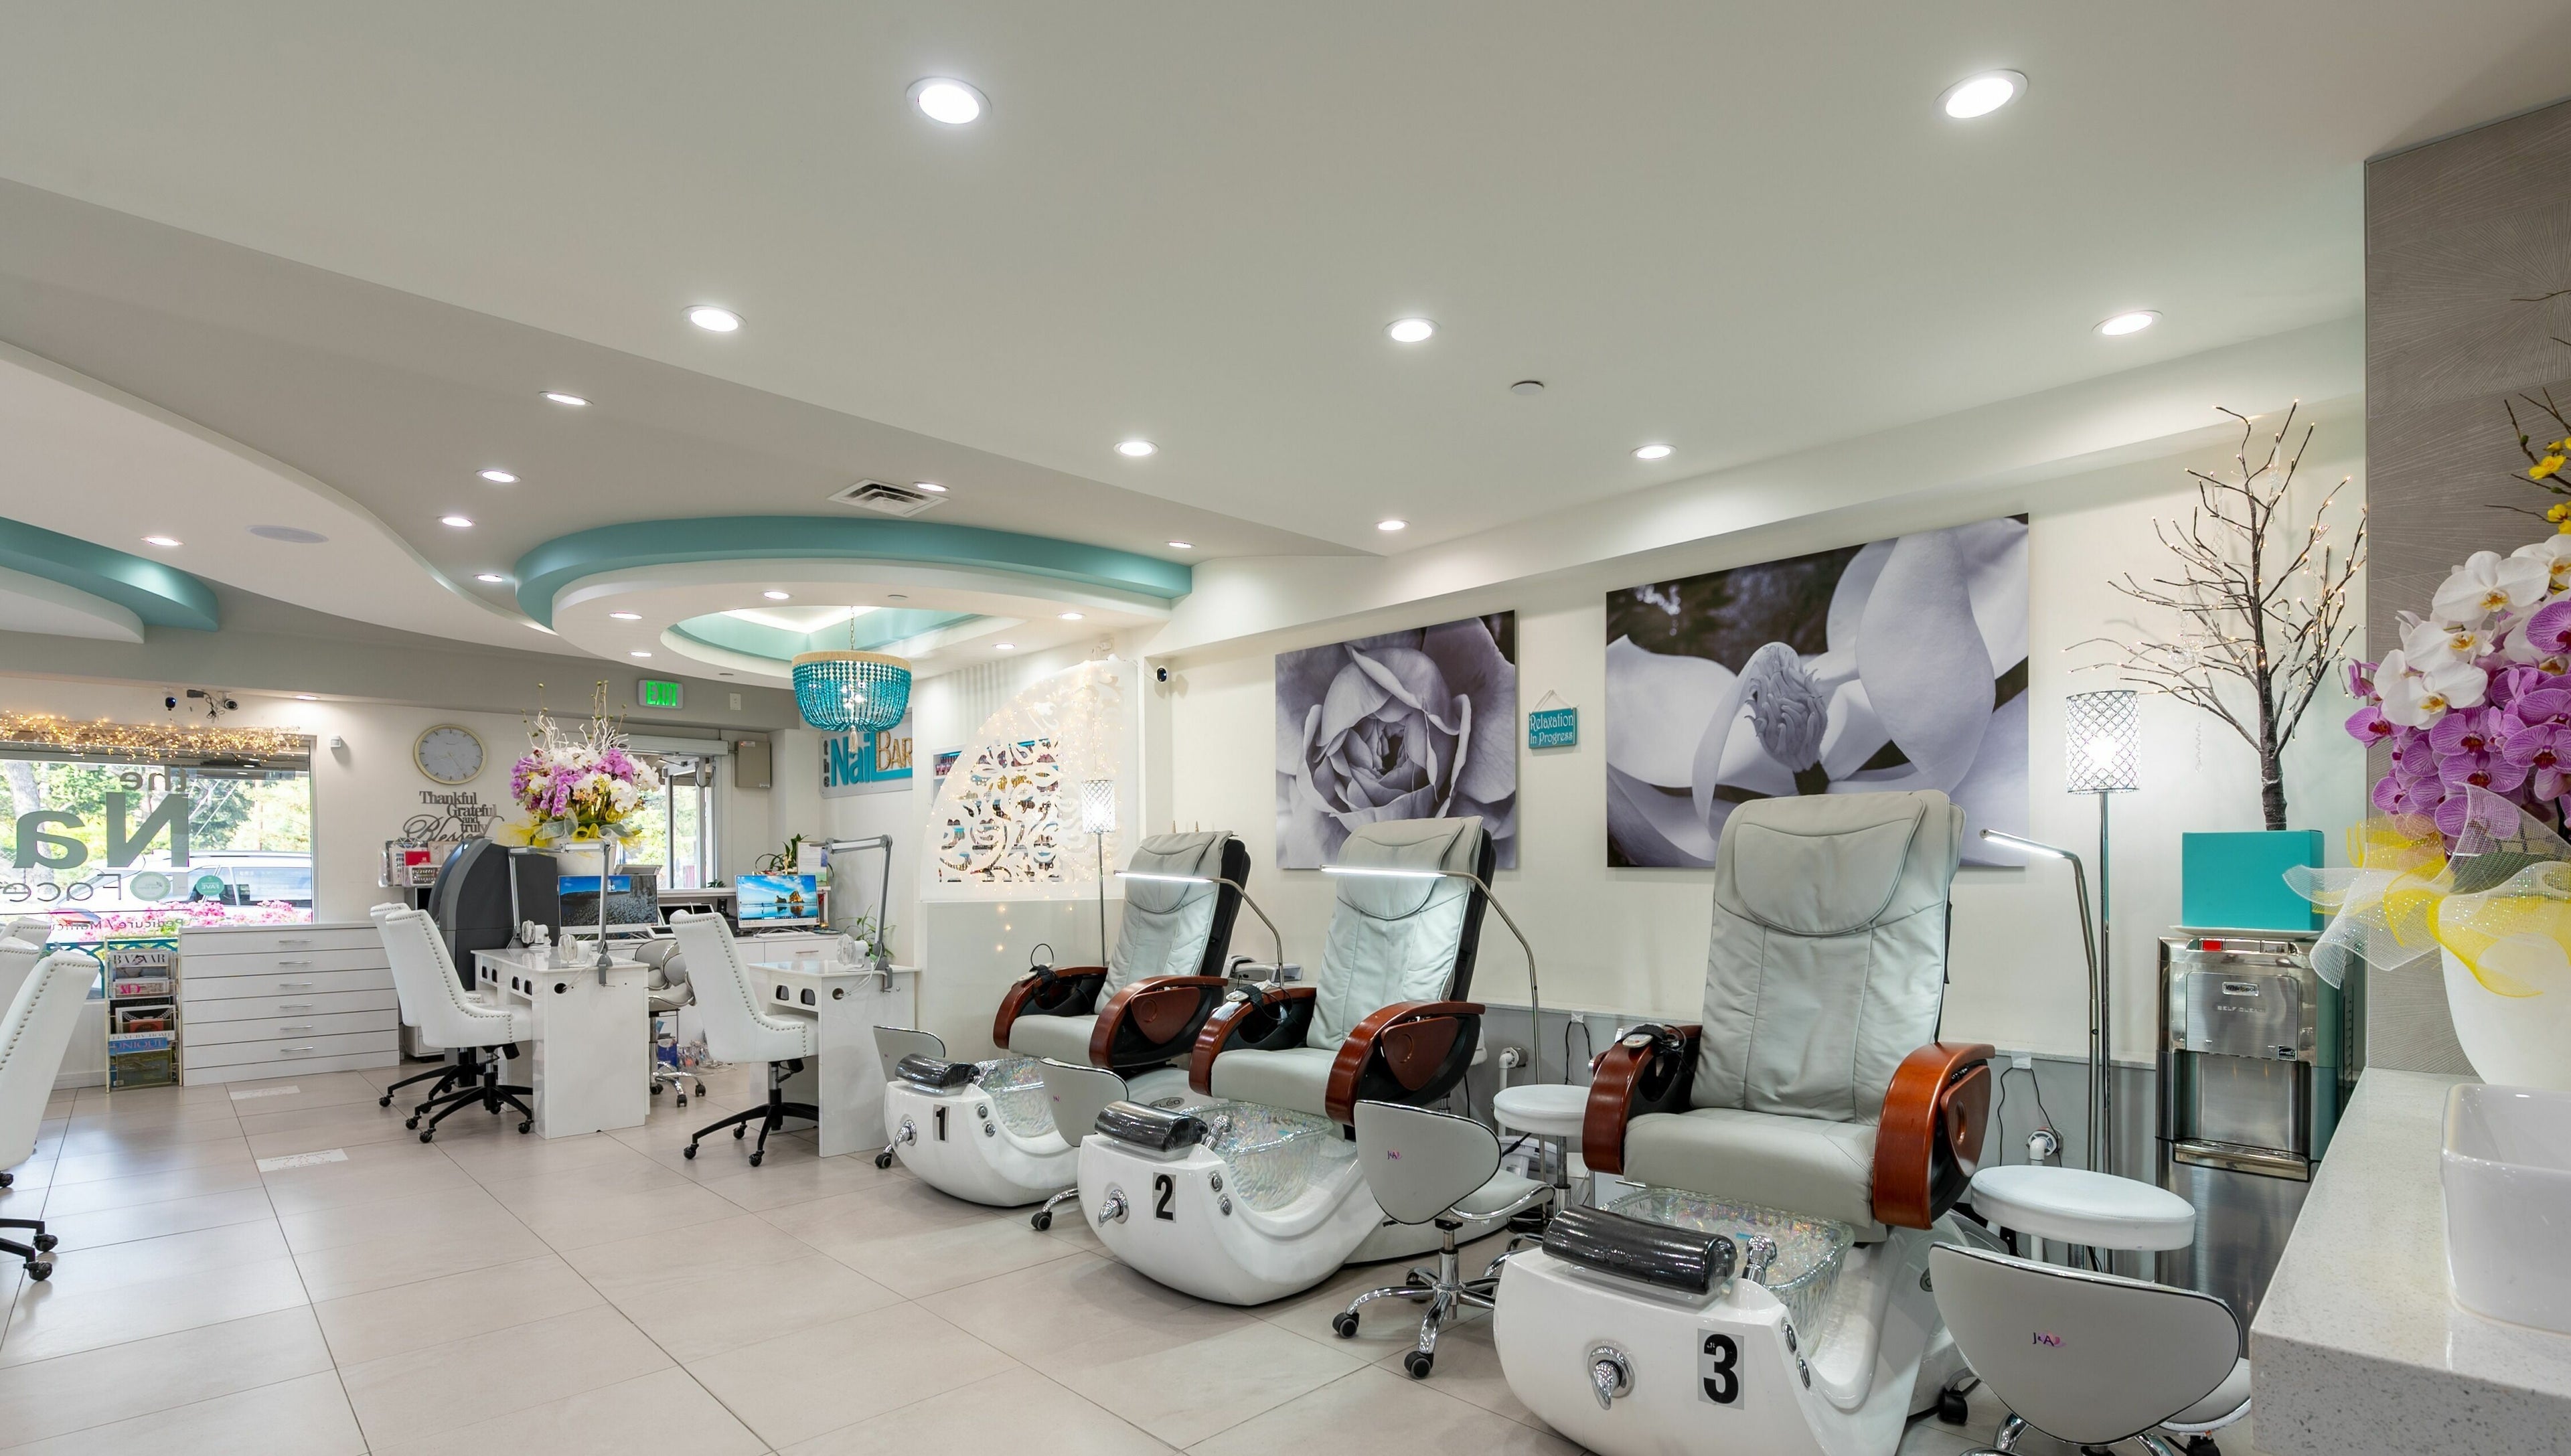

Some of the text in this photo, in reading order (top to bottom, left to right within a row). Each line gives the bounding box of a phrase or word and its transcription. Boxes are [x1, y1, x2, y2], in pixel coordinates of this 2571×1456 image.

[646, 681, 678, 706] EXIT
[1530, 713, 1573, 732] Relaxation
[1530, 732, 1573, 745] In Progress
[419, 791, 477, 804] Thankful
[447, 804, 497, 817] Grateful
[462, 815, 478, 824] and
[461, 821, 488, 836] truly
[935, 1107, 946, 1141] 1
[1155, 1174, 1174, 1221] 2
[1703, 1333, 1739, 1404] 3
